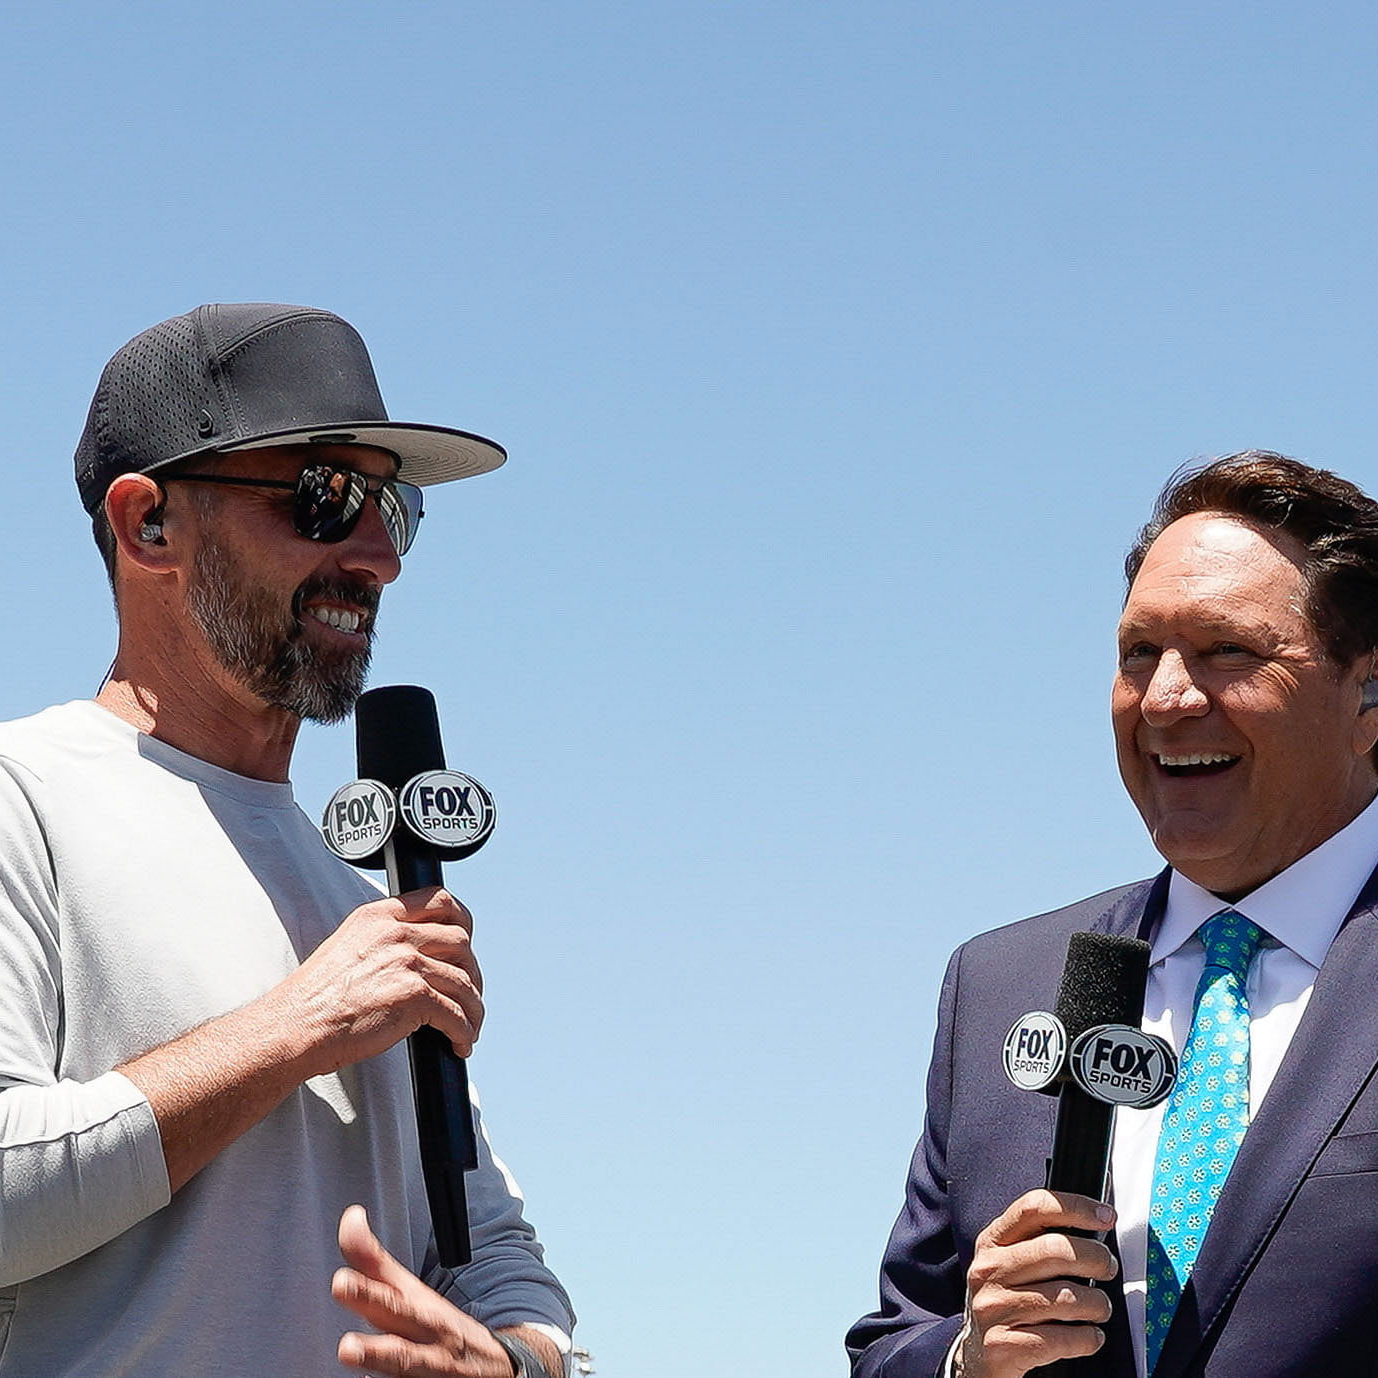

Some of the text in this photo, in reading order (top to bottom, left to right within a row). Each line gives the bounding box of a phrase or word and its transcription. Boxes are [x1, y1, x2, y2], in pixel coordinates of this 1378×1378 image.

[334, 792, 379, 833] FOX
[420, 786, 475, 817] FOX
[337, 823, 382, 846] SPORTS
[423, 817, 478, 830] SPORTS
[1016, 1028, 1054, 1061] FOX
[1013, 1060, 1050, 1074] SPORTS
[1092, 1038, 1158, 1081] FOX
[1089, 1070, 1152, 1093] SPORTS
